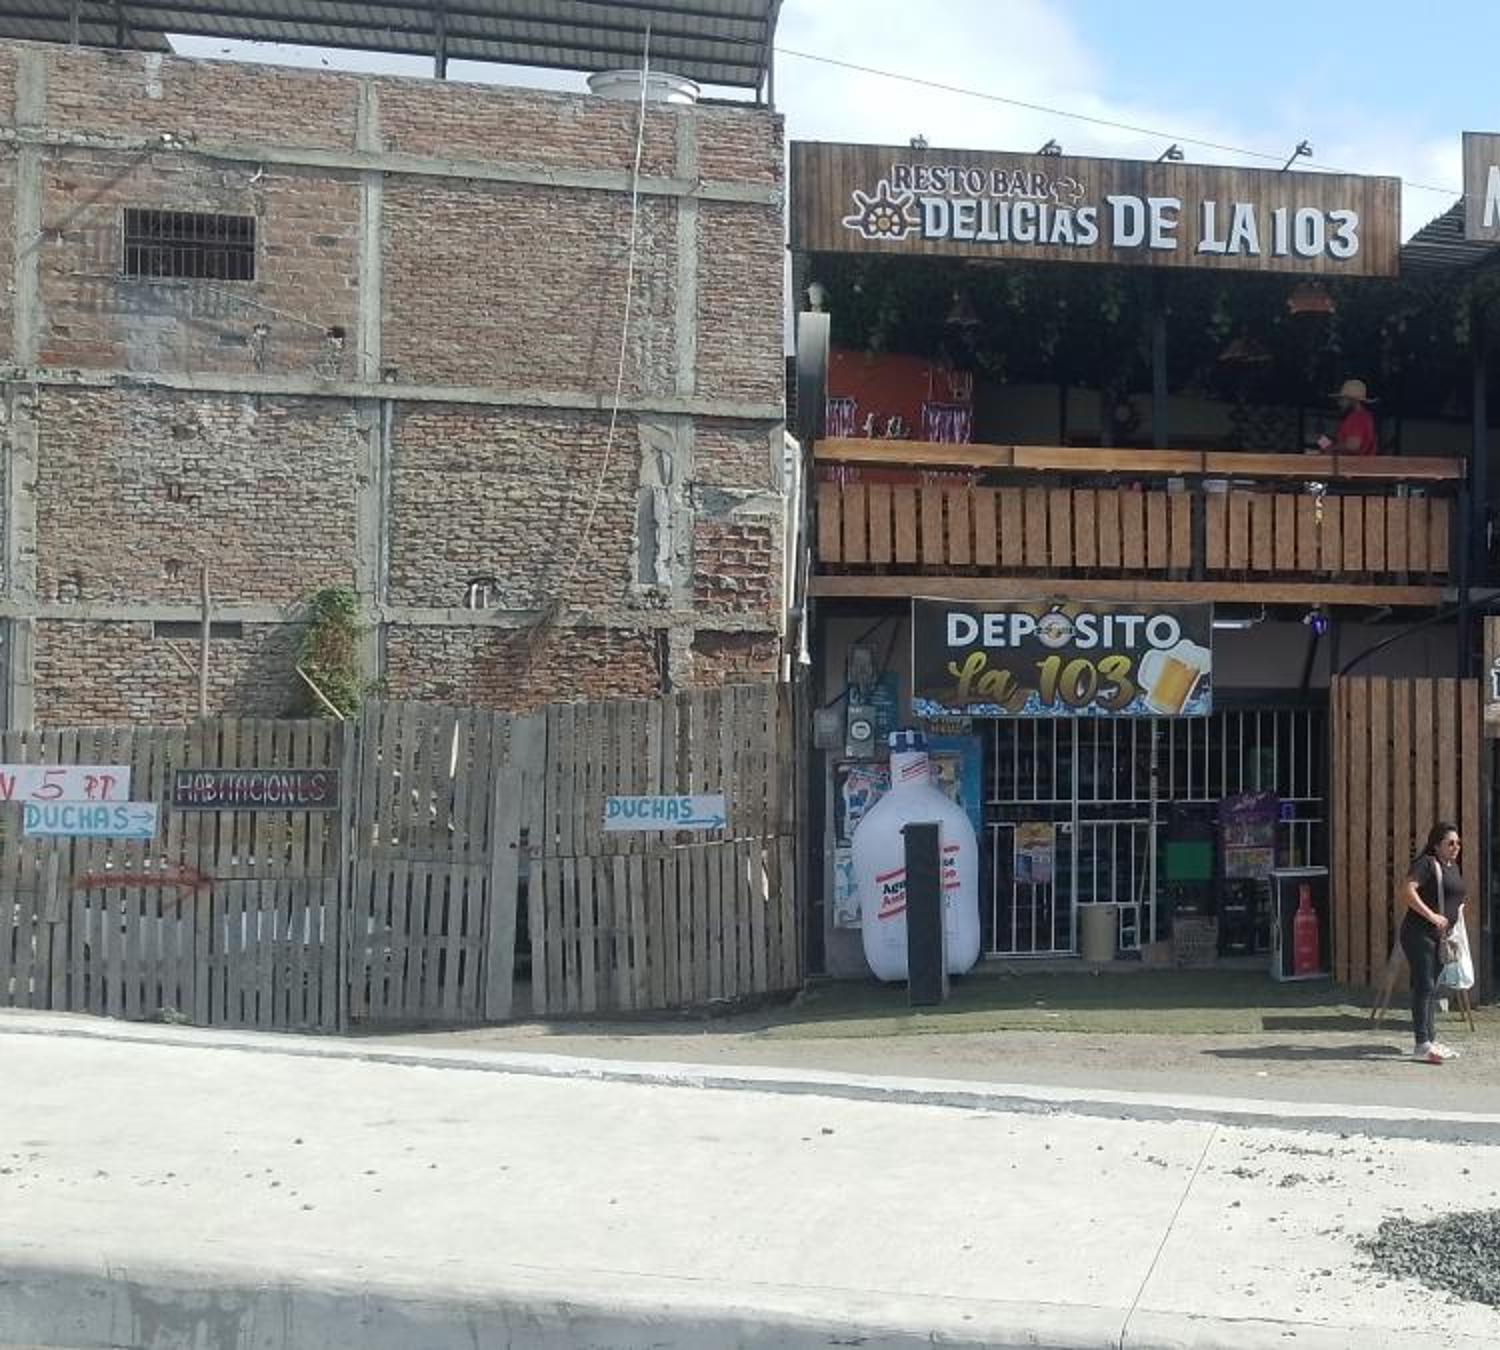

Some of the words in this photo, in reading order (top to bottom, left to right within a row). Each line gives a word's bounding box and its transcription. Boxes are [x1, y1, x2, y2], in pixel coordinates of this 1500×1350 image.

[892, 164, 987, 194] RESTO
[992, 170, 1050, 199] BAR
[917, 196, 1099, 246] DELICIAS
[1105, 194, 1181, 250] DE
[1197, 201, 1261, 255] LA
[1272, 207, 1360, 259] 103
[947, 605, 1181, 649] DEPÓSITO
[947, 651, 1020, 707] La
[1036, 654, 1136, 711] 103
[32, 769, 67, 800] 5
[26, 804, 129, 830] DUCHAS
[607, 798, 693, 819] DUCHAS
